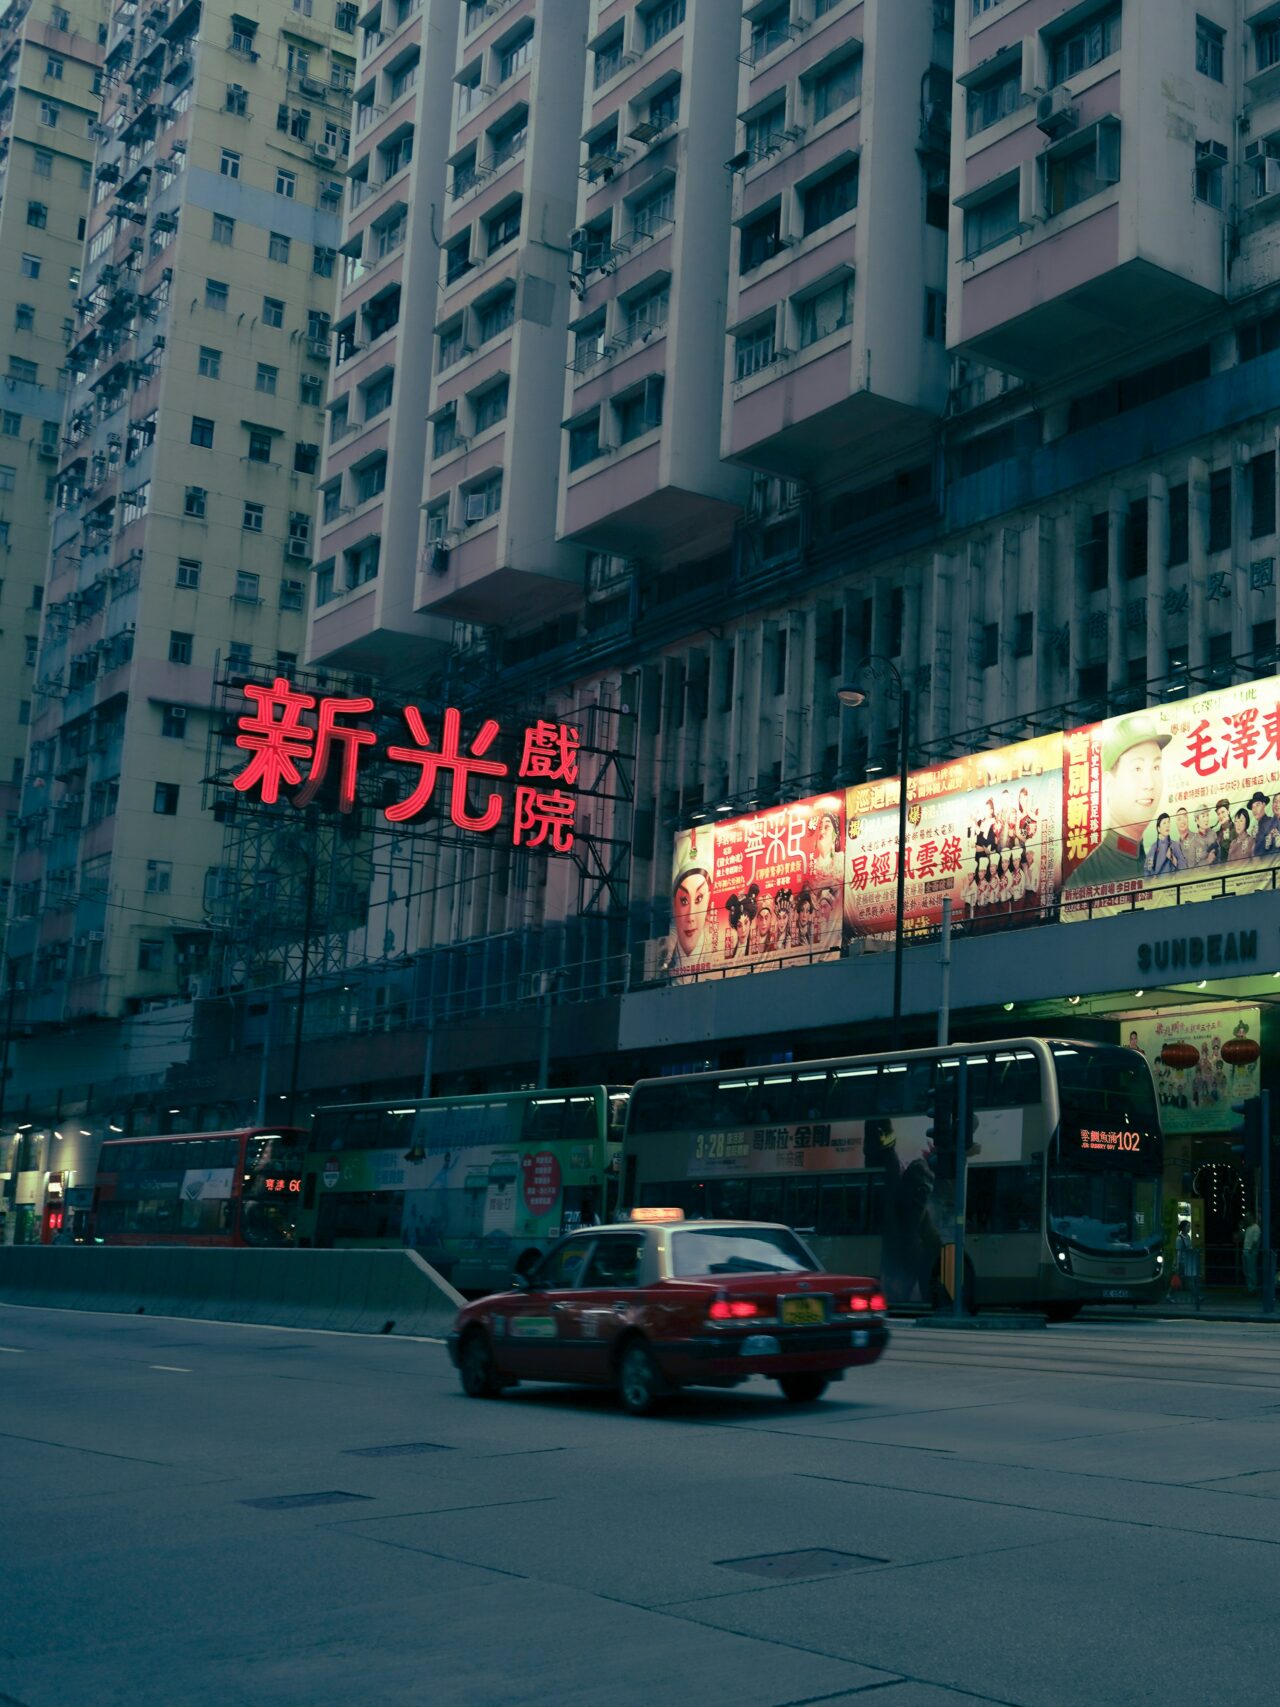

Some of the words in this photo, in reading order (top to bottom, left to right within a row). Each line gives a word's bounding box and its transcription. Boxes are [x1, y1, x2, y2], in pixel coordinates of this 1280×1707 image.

[232, 677, 508, 833] 新光
[513, 719, 581, 852] 戲院
[1137, 929, 1258, 971] SUNBEAM
[1116, 1131, 1140, 1152] 102
